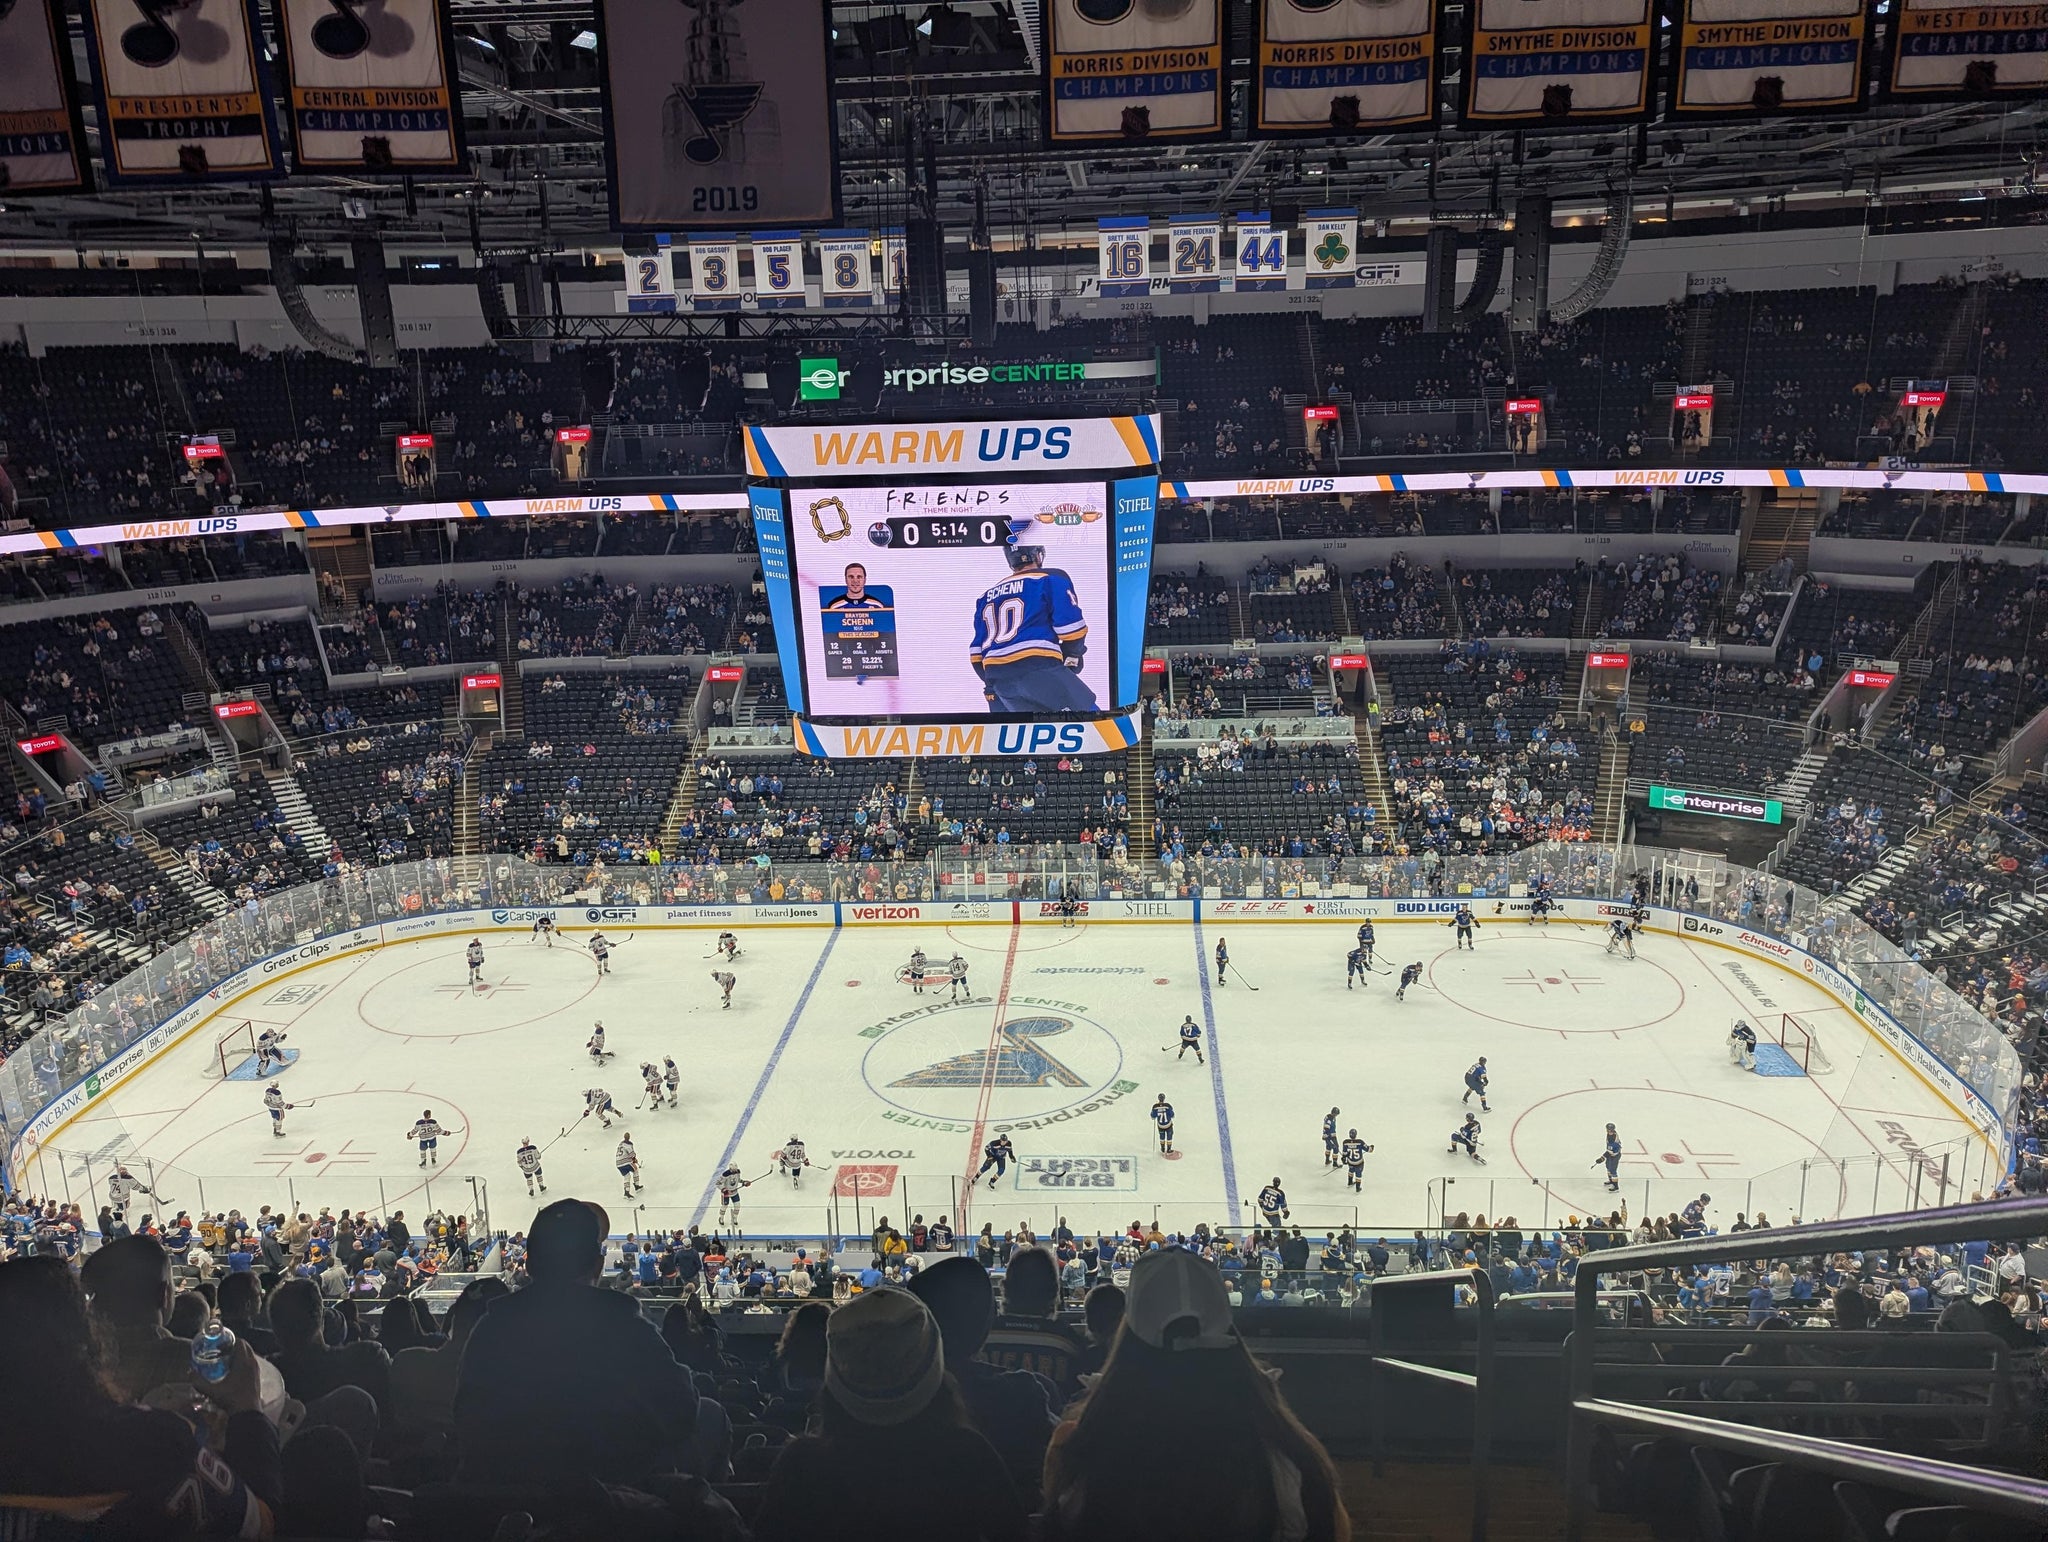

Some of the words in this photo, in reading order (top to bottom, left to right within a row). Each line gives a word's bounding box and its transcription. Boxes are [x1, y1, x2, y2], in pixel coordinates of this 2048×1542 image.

[1915, 11, 1967, 28] WEST
[1488, 33, 1555, 52] SMYTHE
[1561, 30, 1637, 49] DIVISION
[1696, 26, 1767, 46] SMYTHE
[1771, 23, 1851, 42] DIVISION
[1271, 46, 1335, 63] NORRIS
[1343, 41, 1422, 61] DIVISION
[1696, 43, 1851, 66] CHAMPIONS
[1062, 56, 1124, 74] NORRIS
[1132, 51, 1210, 71] DIVISION
[1487, 52, 1637, 75] CHAMPIONS
[1272, 62, 1423, 86] CHAMPIONS
[1063, 73, 1209, 97] CHAMPIONS
[303, 91, 369, 107] CENTRAL
[375, 90, 440, 106] DIVISION
[144, 119, 231, 138] TROPHY
[304, 111, 442, 130] CHAMPIONS
[692, 186, 759, 212] 2019
[1193, 227, 1216, 235] FEDERKO
[1317, 223, 1330, 231] DAN
[1331, 223, 1347, 231] KELLY
[1107, 241, 1143, 279] 16
[1175, 236, 1215, 274] 24
[1239, 236, 1285, 272] 44
[639, 259, 660, 293] 2
[703, 256, 727, 291] 3
[767, 254, 792, 290] 5
[834, 253, 860, 290] 8
[1355, 278, 1400, 286] DIGITAL
[1120, 303, 1135, 311] 320
[991, 362, 1085, 382] CENTER
[410, 437, 430, 445] TOYOTA
[569, 431, 588, 439] TOYOTA
[197, 447, 218, 455] TOYOTA
[813, 429, 965, 466] WARM
[978, 426, 1072, 461] UPS
[1236, 480, 1294, 494] WARM
[1298, 478, 1335, 492] UPS
[1614, 471, 1679, 485] WARM
[1683, 471, 1725, 485] UPS
[525, 498, 583, 513] WARM
[588, 497, 622, 511] UPS
[754, 504, 782, 522] STIFEL
[1118, 496, 1153, 515] STIFEL
[122, 521, 190, 539] WARM
[197, 518, 238, 533] UPS
[903, 523, 920, 545] 0
[931, 522, 969, 537] 5:14
[980, 521, 996, 544] 0
[1123, 524, 1146, 534] WHERE
[762, 546, 784, 555] SUCCESS
[1119, 537, 1149, 548] SUCCESS
[1122, 550, 1144, 560] MEETS
[765, 570, 788, 580] SUCCESS
[1118, 561, 1148, 573] SUCCESS
[986, 579, 1025, 603] SCHENN
[841, 618, 874, 626] SCHENN
[981, 597, 1025, 650] 10
[830, 642, 840, 650] 12
[880, 641, 886, 649] 3
[720, 670, 740, 678] TOYOTA
[1866, 676, 1890, 685] TOYOTA
[230, 705, 254, 714] TOYOTA
[32, 740, 56, 752] TOYOTA
[843, 725, 985, 757] WARM
[996, 723, 1085, 754] UPS
[1668, 793, 1765, 815] enterprise
[755, 907, 789, 917] Edward
[789, 908, 818, 918] Jones
[851, 904, 920, 920] verizon
[1125, 901, 1172, 915] STIFEL
[1316, 907, 1380, 916] COMMUNITY
[1317, 901, 1345, 909] FIRST
[1397, 903, 1426, 914] BUD
[667, 909, 697, 920] planet
[699, 909, 732, 918] fitness
[396, 923, 423, 932] Anthem
[1736, 931, 1793, 956] Schnucks
[263, 954, 298, 973] Great
[299, 941, 331, 959] Clips
[951, 962, 961, 971] 14
[1029, 966, 1146, 976] ticketmaster
[221, 976, 235, 989] World
[234, 971, 248, 982] Wide
[222, 978, 249, 996] Technology
[1010, 995, 1089, 1014] CENTER
[1857, 996, 1899, 1041] enterprise
[148, 1034, 164, 1049] BJC
[164, 1007, 201, 1039] HealthCare
[1183, 1026, 1193, 1036] 17
[87, 1047, 144, 1093] enterprise
[1903, 1039, 1916, 1057] BJC
[1916, 1047, 1952, 1090] HealthCare
[881, 1109, 972, 1134] CENTER
[1157, 1112, 1168, 1122] 71
[521, 1155, 534, 1166] 49
[789, 1147, 802, 1158] 48
[830, 1149, 916, 1159] TOYOTA
[1348, 1148, 1361, 1160] 75
[1025, 1158, 1130, 1173] LIGHT
[1038, 1172, 1115, 1187] BUD
[110, 1184, 121, 1195] 74
[1263, 1192, 1278, 1209] 55
